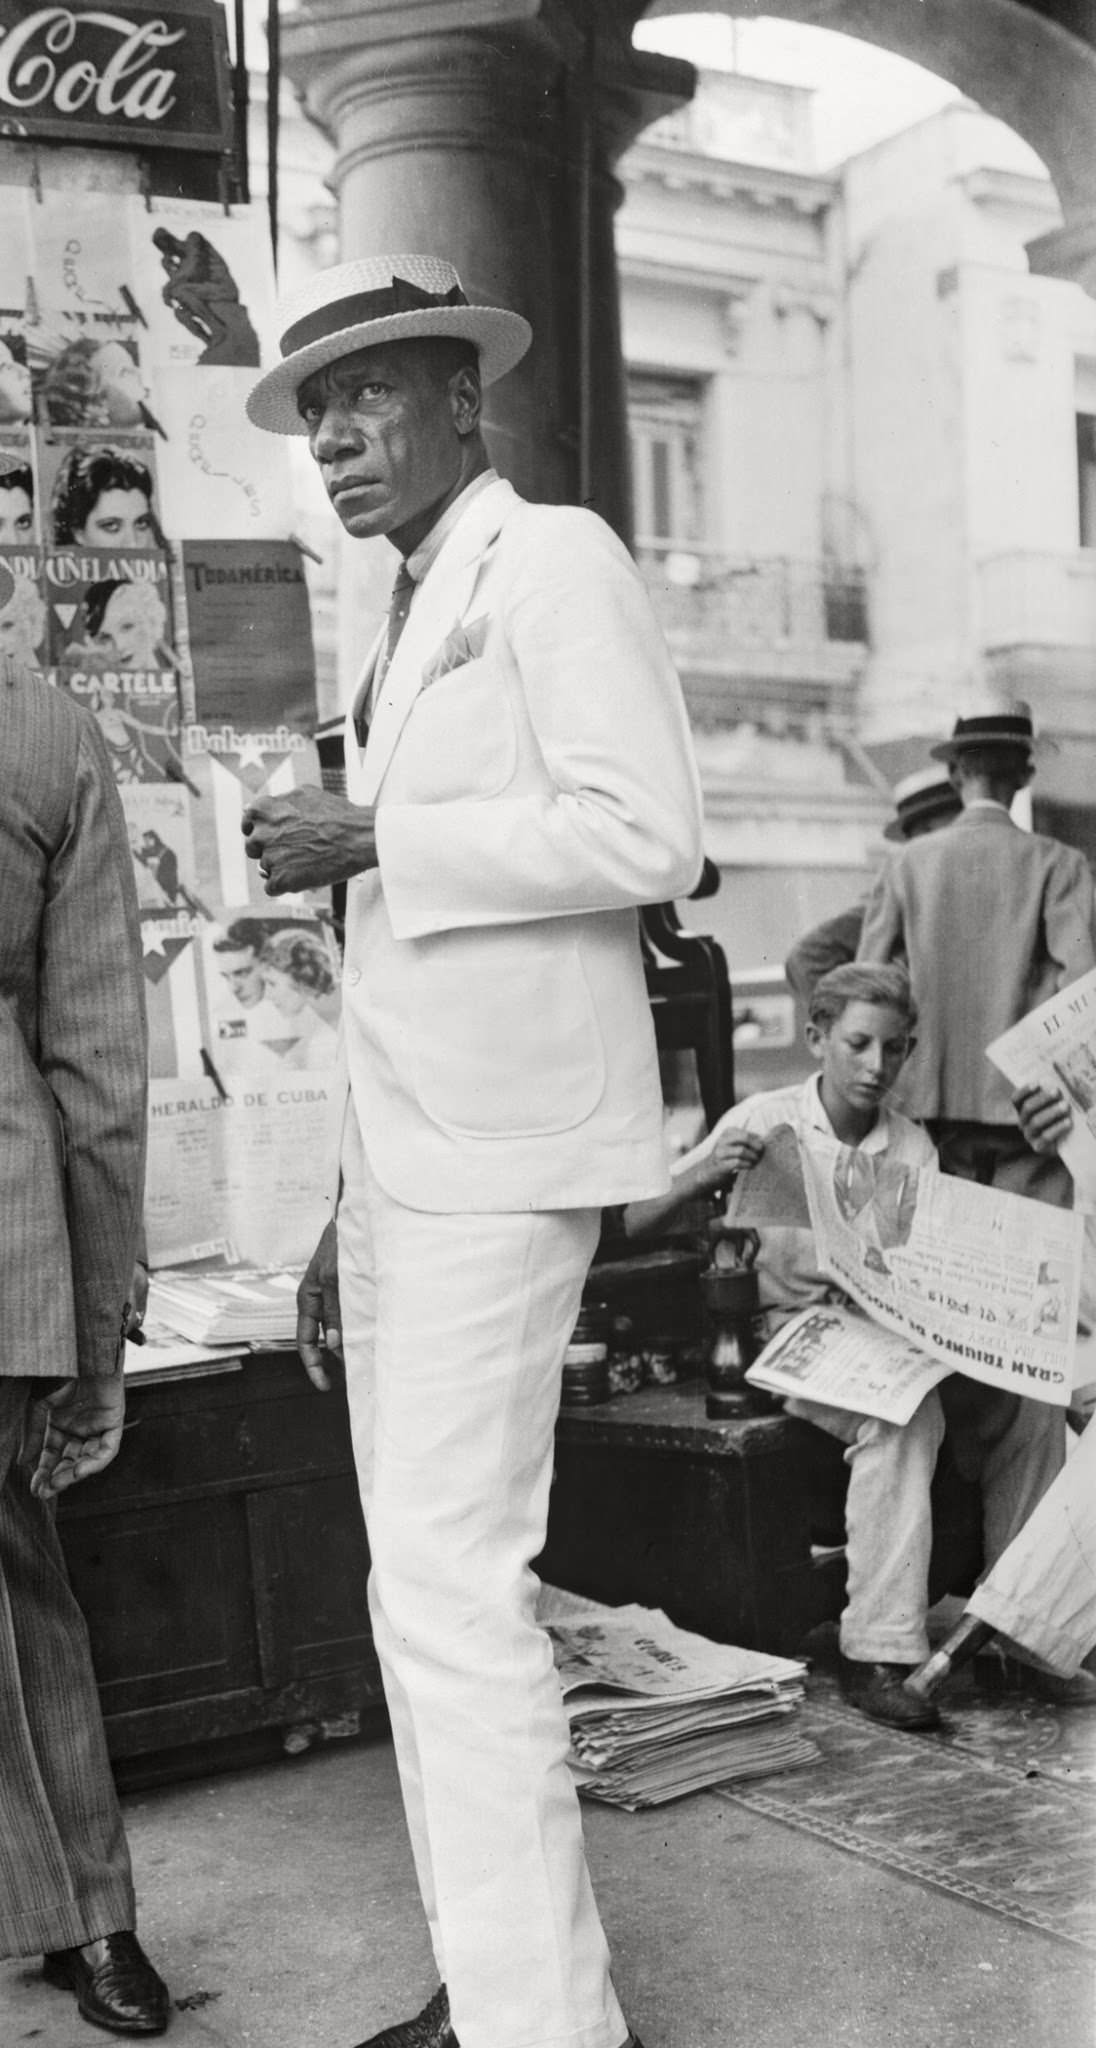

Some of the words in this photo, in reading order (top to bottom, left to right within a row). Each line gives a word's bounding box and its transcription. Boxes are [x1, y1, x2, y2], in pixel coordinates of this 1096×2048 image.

[0, 8, 187, 120] Cola
[151, 1094, 235, 1118] HERALDO
[242, 1092, 268, 1108] DE
[276, 1088, 329, 1105] CUBA
[932, 1332, 1004, 1370] TRIUNFO
[1011, 1360, 1065, 1384] GRAN
